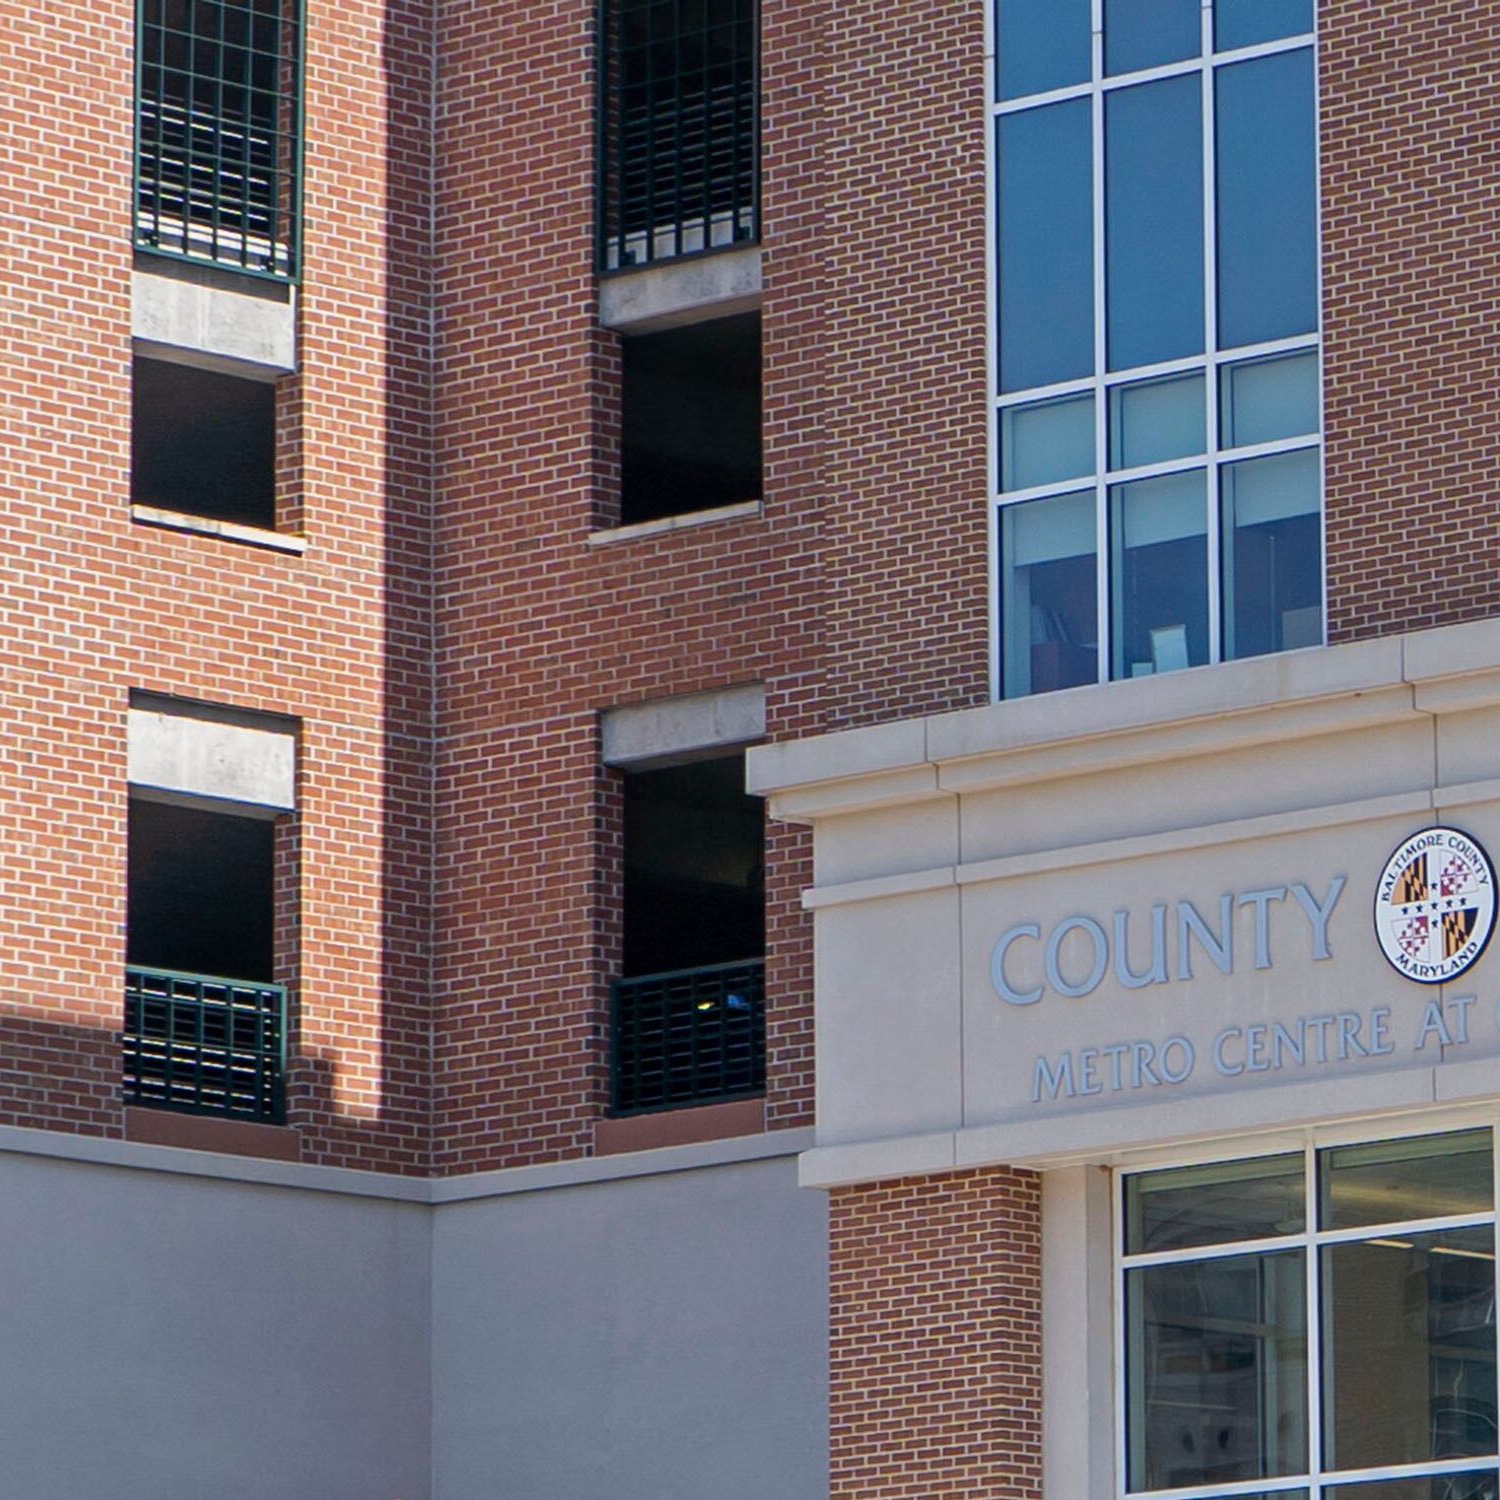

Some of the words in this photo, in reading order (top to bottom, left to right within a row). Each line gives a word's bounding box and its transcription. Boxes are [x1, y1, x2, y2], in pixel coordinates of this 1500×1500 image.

[1381, 834, 1443, 902] BALTIMORE
[1448, 836, 1489, 886] COUNTY
[990, 878, 1345, 1006] COUNTY
[1396, 941, 1478, 977] MARYLAND
[1031, 1037, 1196, 1102] METRO
[1212, 1008, 1395, 1077] CENTRE
[1414, 995, 1477, 1051] AT
